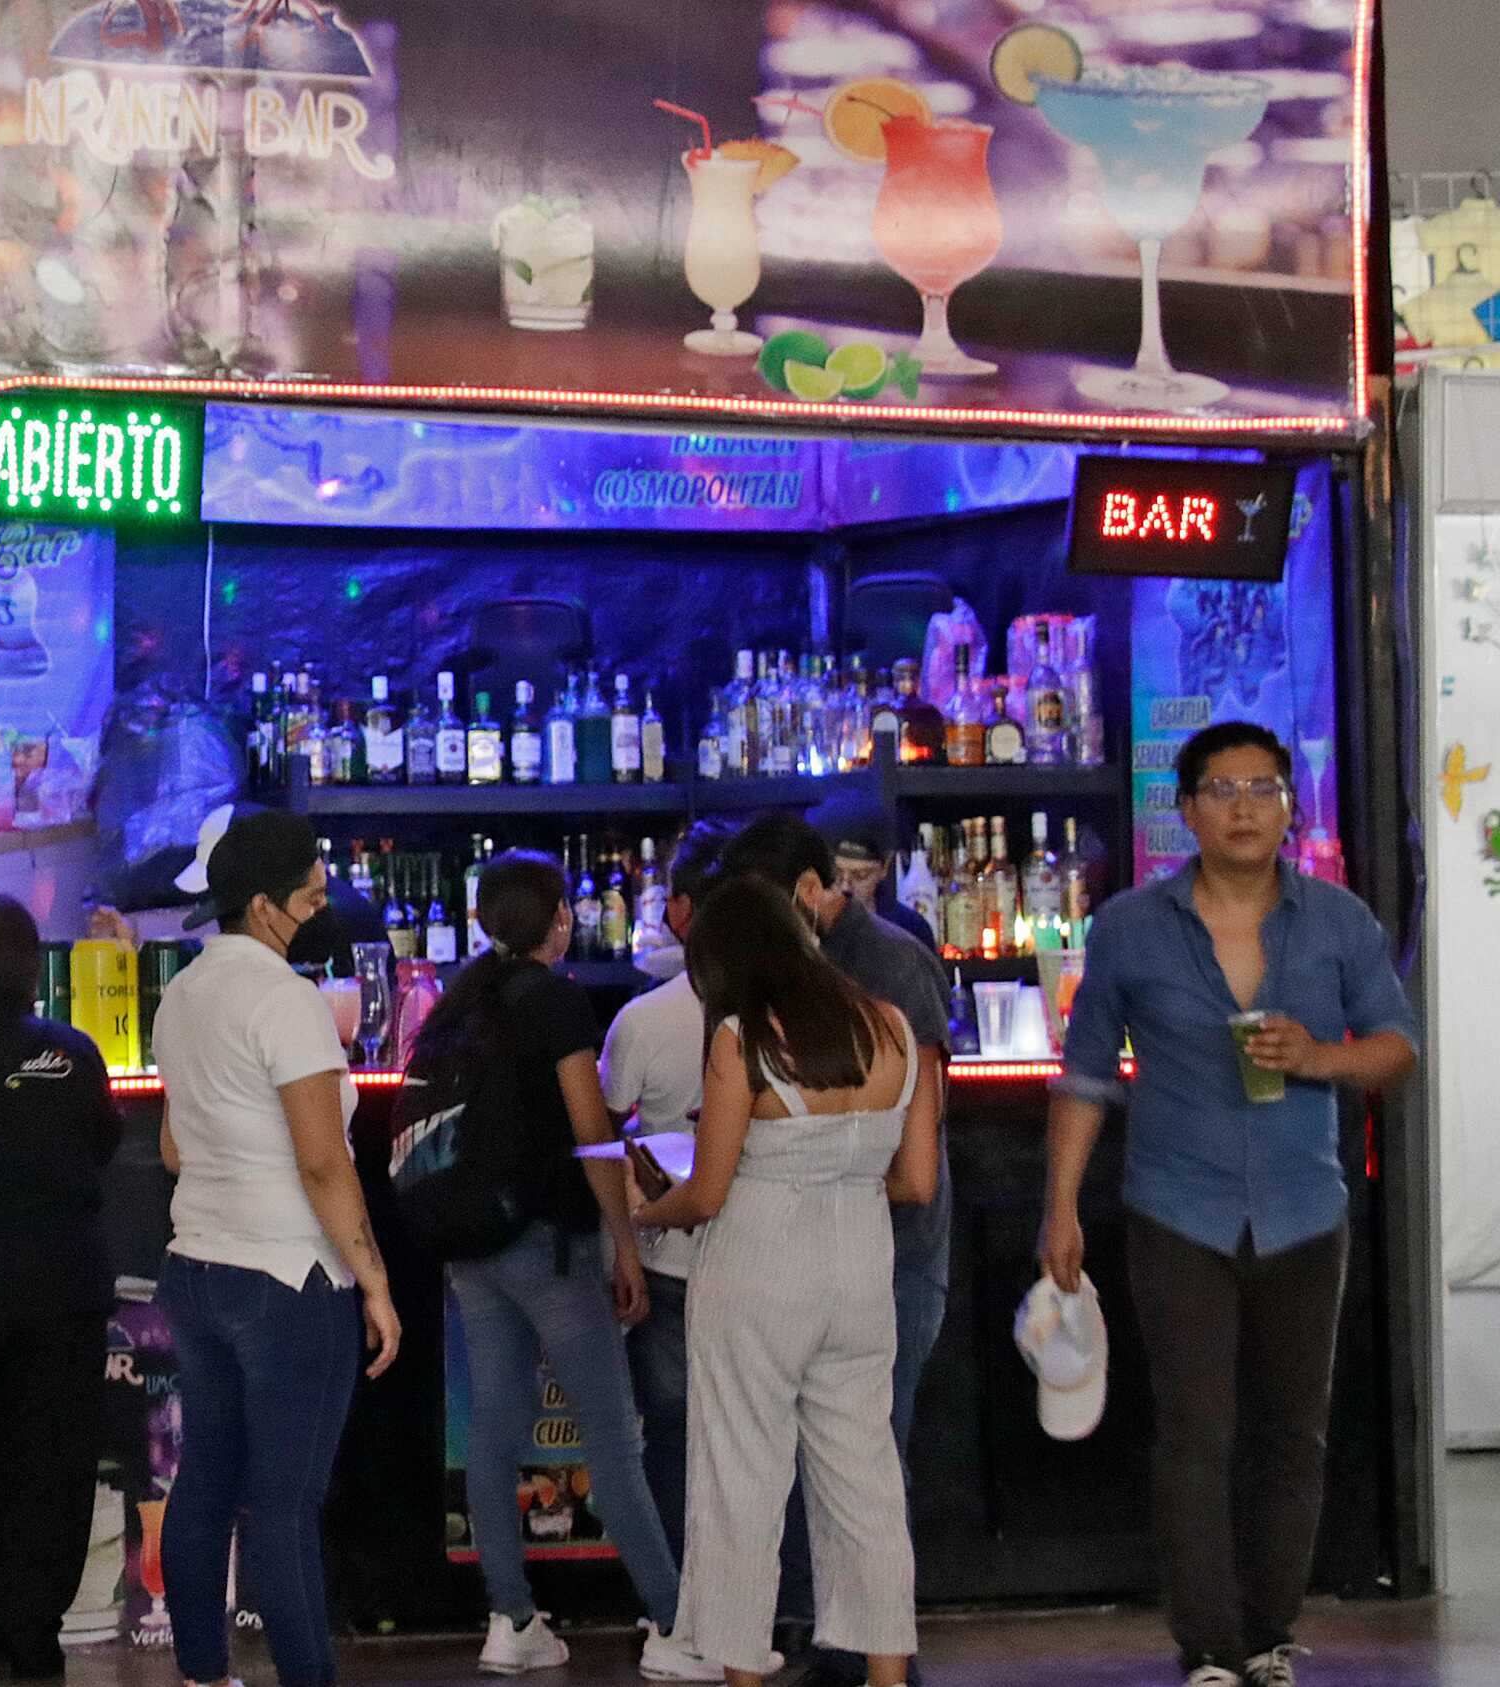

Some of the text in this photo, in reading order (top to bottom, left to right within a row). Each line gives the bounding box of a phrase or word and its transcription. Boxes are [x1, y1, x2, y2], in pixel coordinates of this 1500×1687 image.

[25, 69, 395, 182] KRAKEN BAR
[596, 472, 799, 506] COSMOPOLITAN
[1101, 490, 1214, 542] BAR
[105, 1352, 145, 1387] AR
